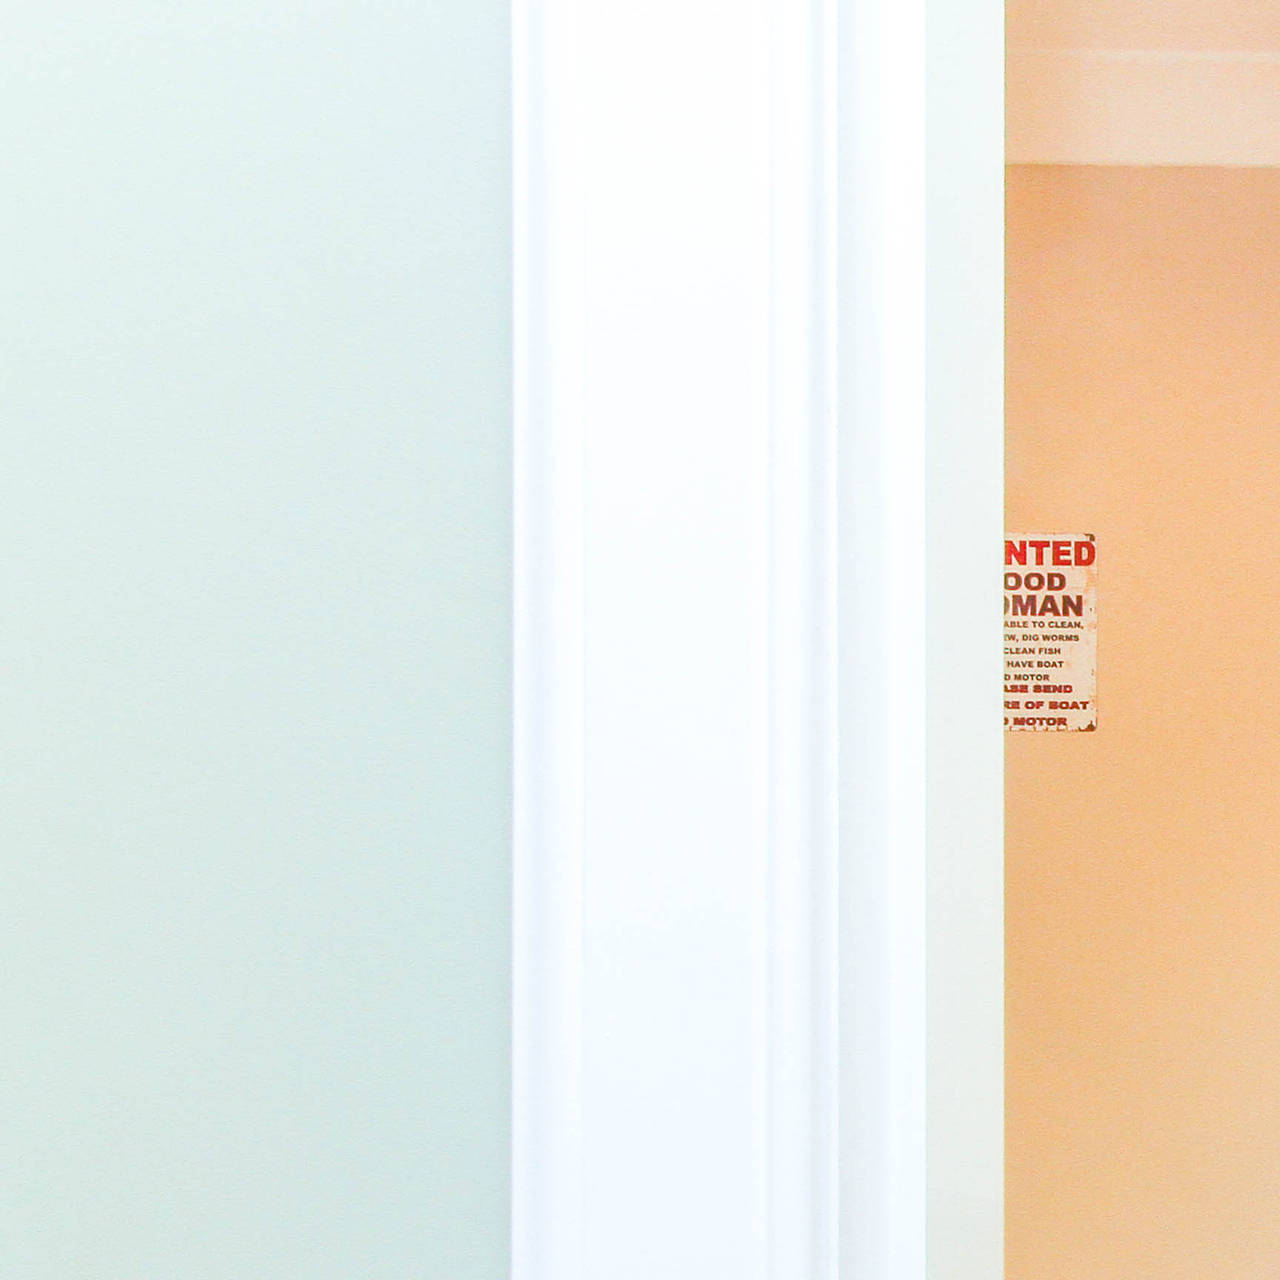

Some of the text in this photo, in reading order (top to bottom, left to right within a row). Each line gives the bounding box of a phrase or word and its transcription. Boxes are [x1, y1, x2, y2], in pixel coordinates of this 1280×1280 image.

[1004, 594, 1083, 616] MAN
[1032, 621, 1045, 629] TO
[1048, 621, 1084, 630] CLEAN,
[1022, 634, 1039, 642] DIG
[1042, 634, 1079, 642] WORMS
[1038, 647, 1061, 655] FISH
[1033, 685, 1073, 693] SEND
[1025, 701, 1044, 710] OF
[1048, 701, 1089, 710] BOAT
[1013, 717, 1067, 726] MOTOR
